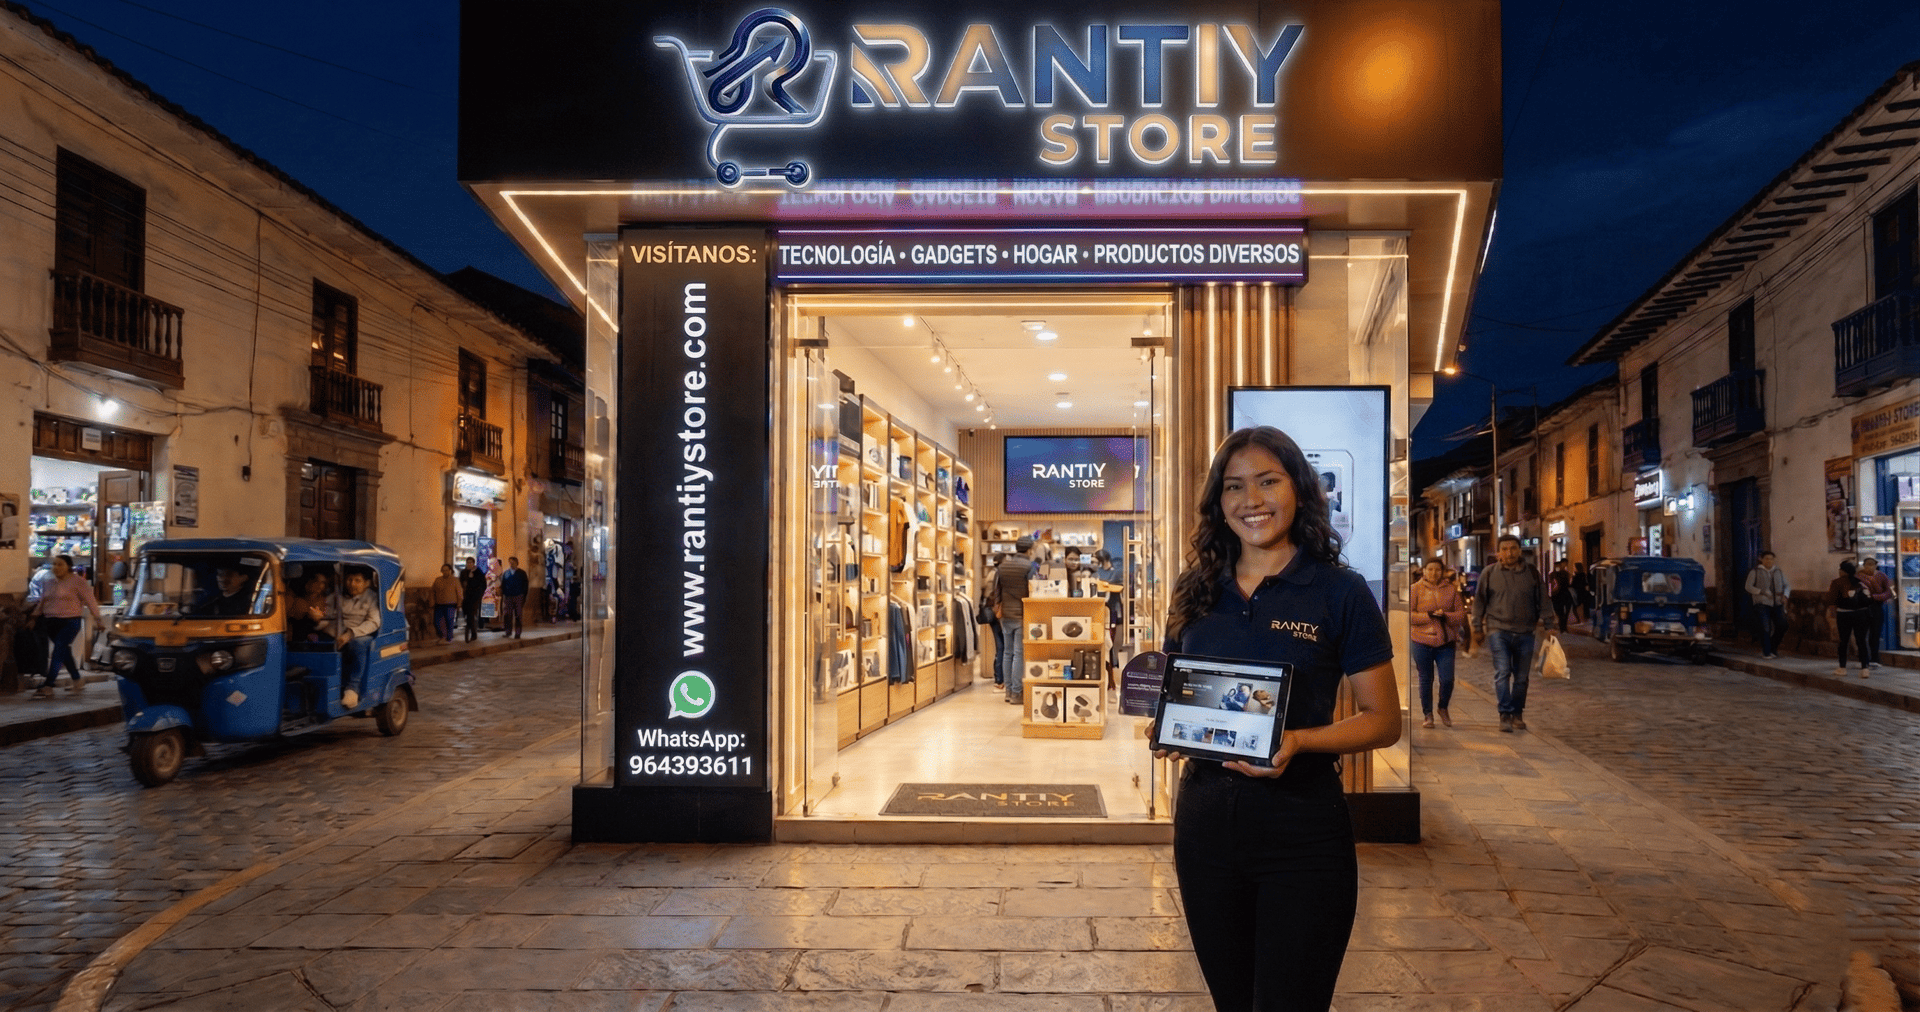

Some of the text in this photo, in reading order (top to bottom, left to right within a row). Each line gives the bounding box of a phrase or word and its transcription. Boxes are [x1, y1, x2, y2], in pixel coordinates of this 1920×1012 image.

[852, 23, 1305, 107] RANTIY
[1039, 113, 1278, 164] STORE
[630, 240, 757, 264] VISÍTANOS:
[779, 240, 1300, 265] TECNOLOGÍA GADGETS HOGAR PRODUCTOS DIVERSOS
[677, 282, 714, 657] www.rantiystore.com
[1032, 463, 1107, 479] RANTIY
[1069, 479, 1105, 488] STORE
[1271, 620, 1319, 634] RANTY
[637, 728, 746, 752] WhatsApp:
[629, 755, 751, 775] 964393611
